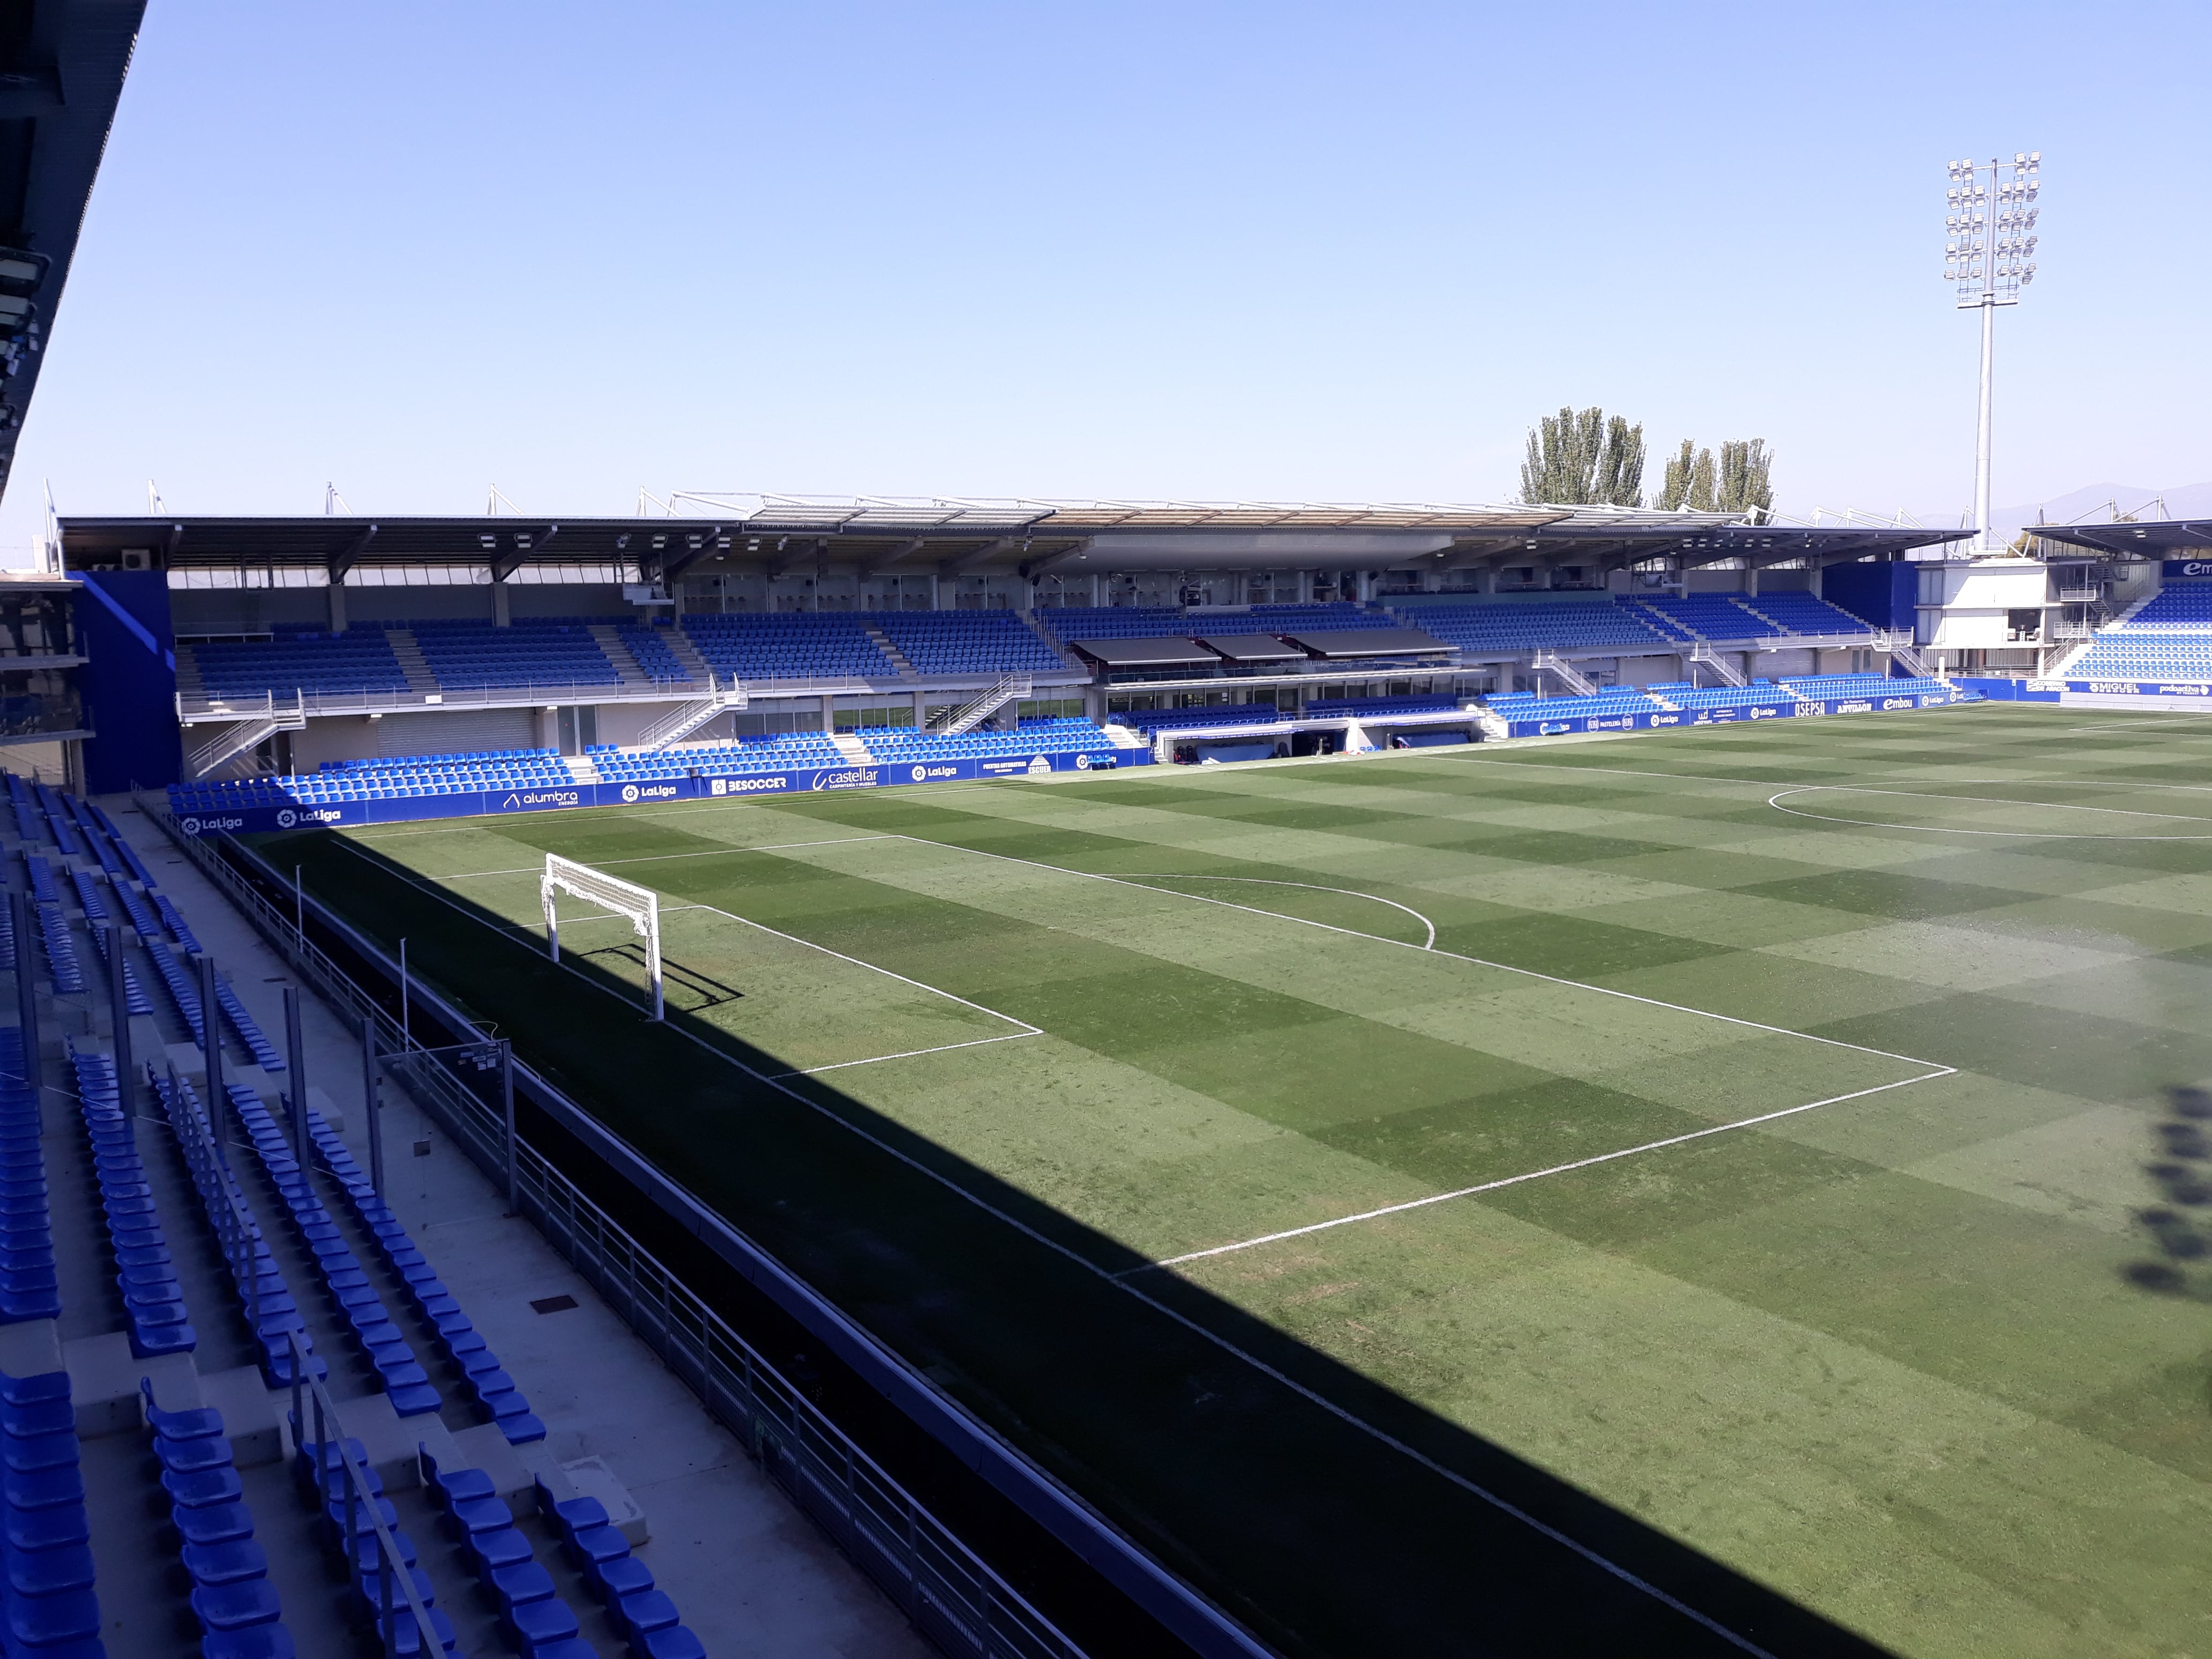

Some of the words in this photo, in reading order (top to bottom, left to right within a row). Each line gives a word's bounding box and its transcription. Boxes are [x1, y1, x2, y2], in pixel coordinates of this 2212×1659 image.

[1795, 701, 1825, 717] OSEPSA
[1883, 697, 1912, 710] embou
[1661, 715, 1678, 724] LaLiga
[828, 767, 878, 784] castellar
[928, 765, 956, 777] LaLiga
[1028, 766, 1051, 774] ESCUER
[642, 785, 676, 797] LaLiga
[729, 778, 786, 791] BESOCCER
[523, 790, 578, 804] alumbra
[300, 809, 341, 822] LaLiga
[203, 817, 243, 830] LaLiga
